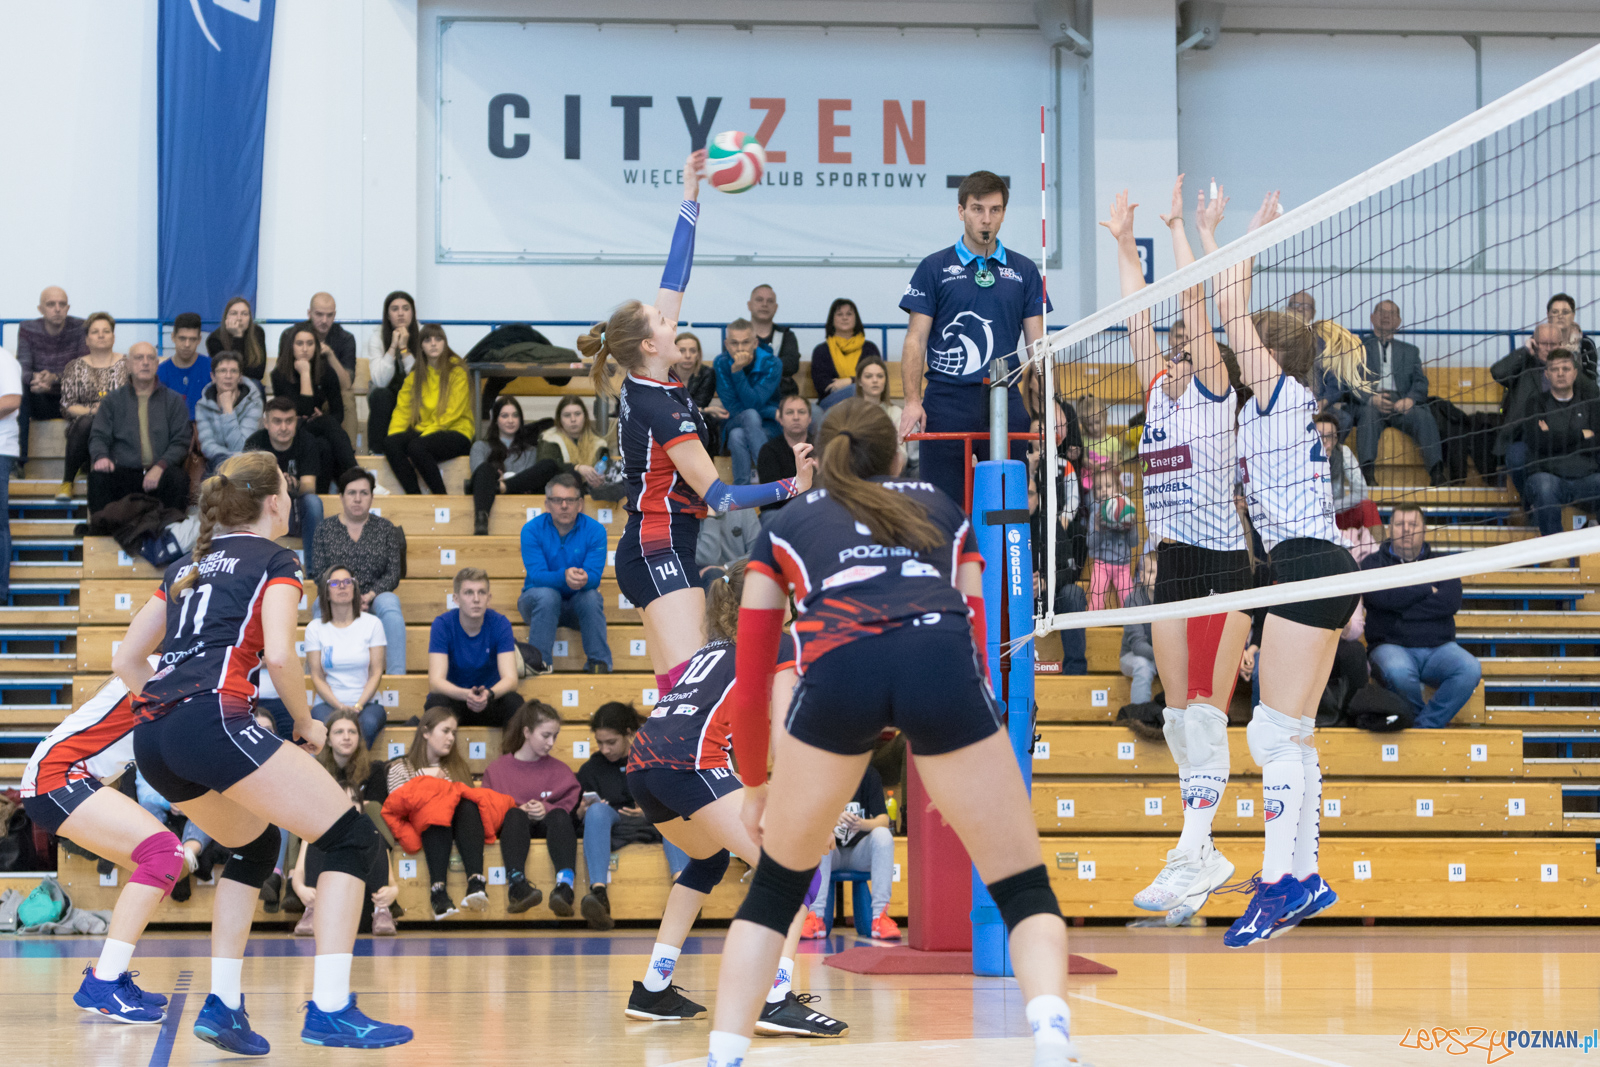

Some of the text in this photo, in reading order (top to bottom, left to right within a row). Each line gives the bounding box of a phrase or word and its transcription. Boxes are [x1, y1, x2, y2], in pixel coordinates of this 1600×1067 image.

[488, 93, 926, 165] CITYZEN
[624, 169, 927, 188] WIĘCE LUB SPORTOWY
[1150, 454, 1184, 468] Energa
[174, 558, 240, 583] ENRGETYK
[655, 561, 678, 580] 14
[1010, 545, 1023, 596] Senoh
[120, 596, 126, 604] 8
[174, 583, 213, 639] 11
[635, 643, 641, 651] 2
[674, 649, 727, 688] 10
[1034, 662, 1059, 672] Senoh
[388, 694, 394, 702] 5
[567, 693, 573, 701] 3
[648, 692, 653, 700] 2
[1095, 692, 1104, 701] 13
[239, 725, 264, 745] 11
[393, 746, 399, 755] 5
[474, 745, 480, 753] 4
[578, 745, 584, 753] 3
[1037, 745, 1046, 753] 14
[1122, 746, 1131, 754] 13
[1386, 746, 1395, 755] 10
[1476, 747, 1482, 756] 9
[1061, 803, 1071, 811] 14
[1149, 801, 1158, 809] 13
[1241, 803, 1250, 811] 12
[1328, 803, 1337, 811] 11
[1421, 803, 1430, 811] 10
[1514, 801, 1520, 810] 9
[404, 863, 410, 872] 5
[1082, 864, 1092, 872] 14
[1357, 865, 1367, 873] 11
[1453, 867, 1462, 875] 10
[1546, 867, 1552, 876] 9
[494, 870, 500, 878] 4
